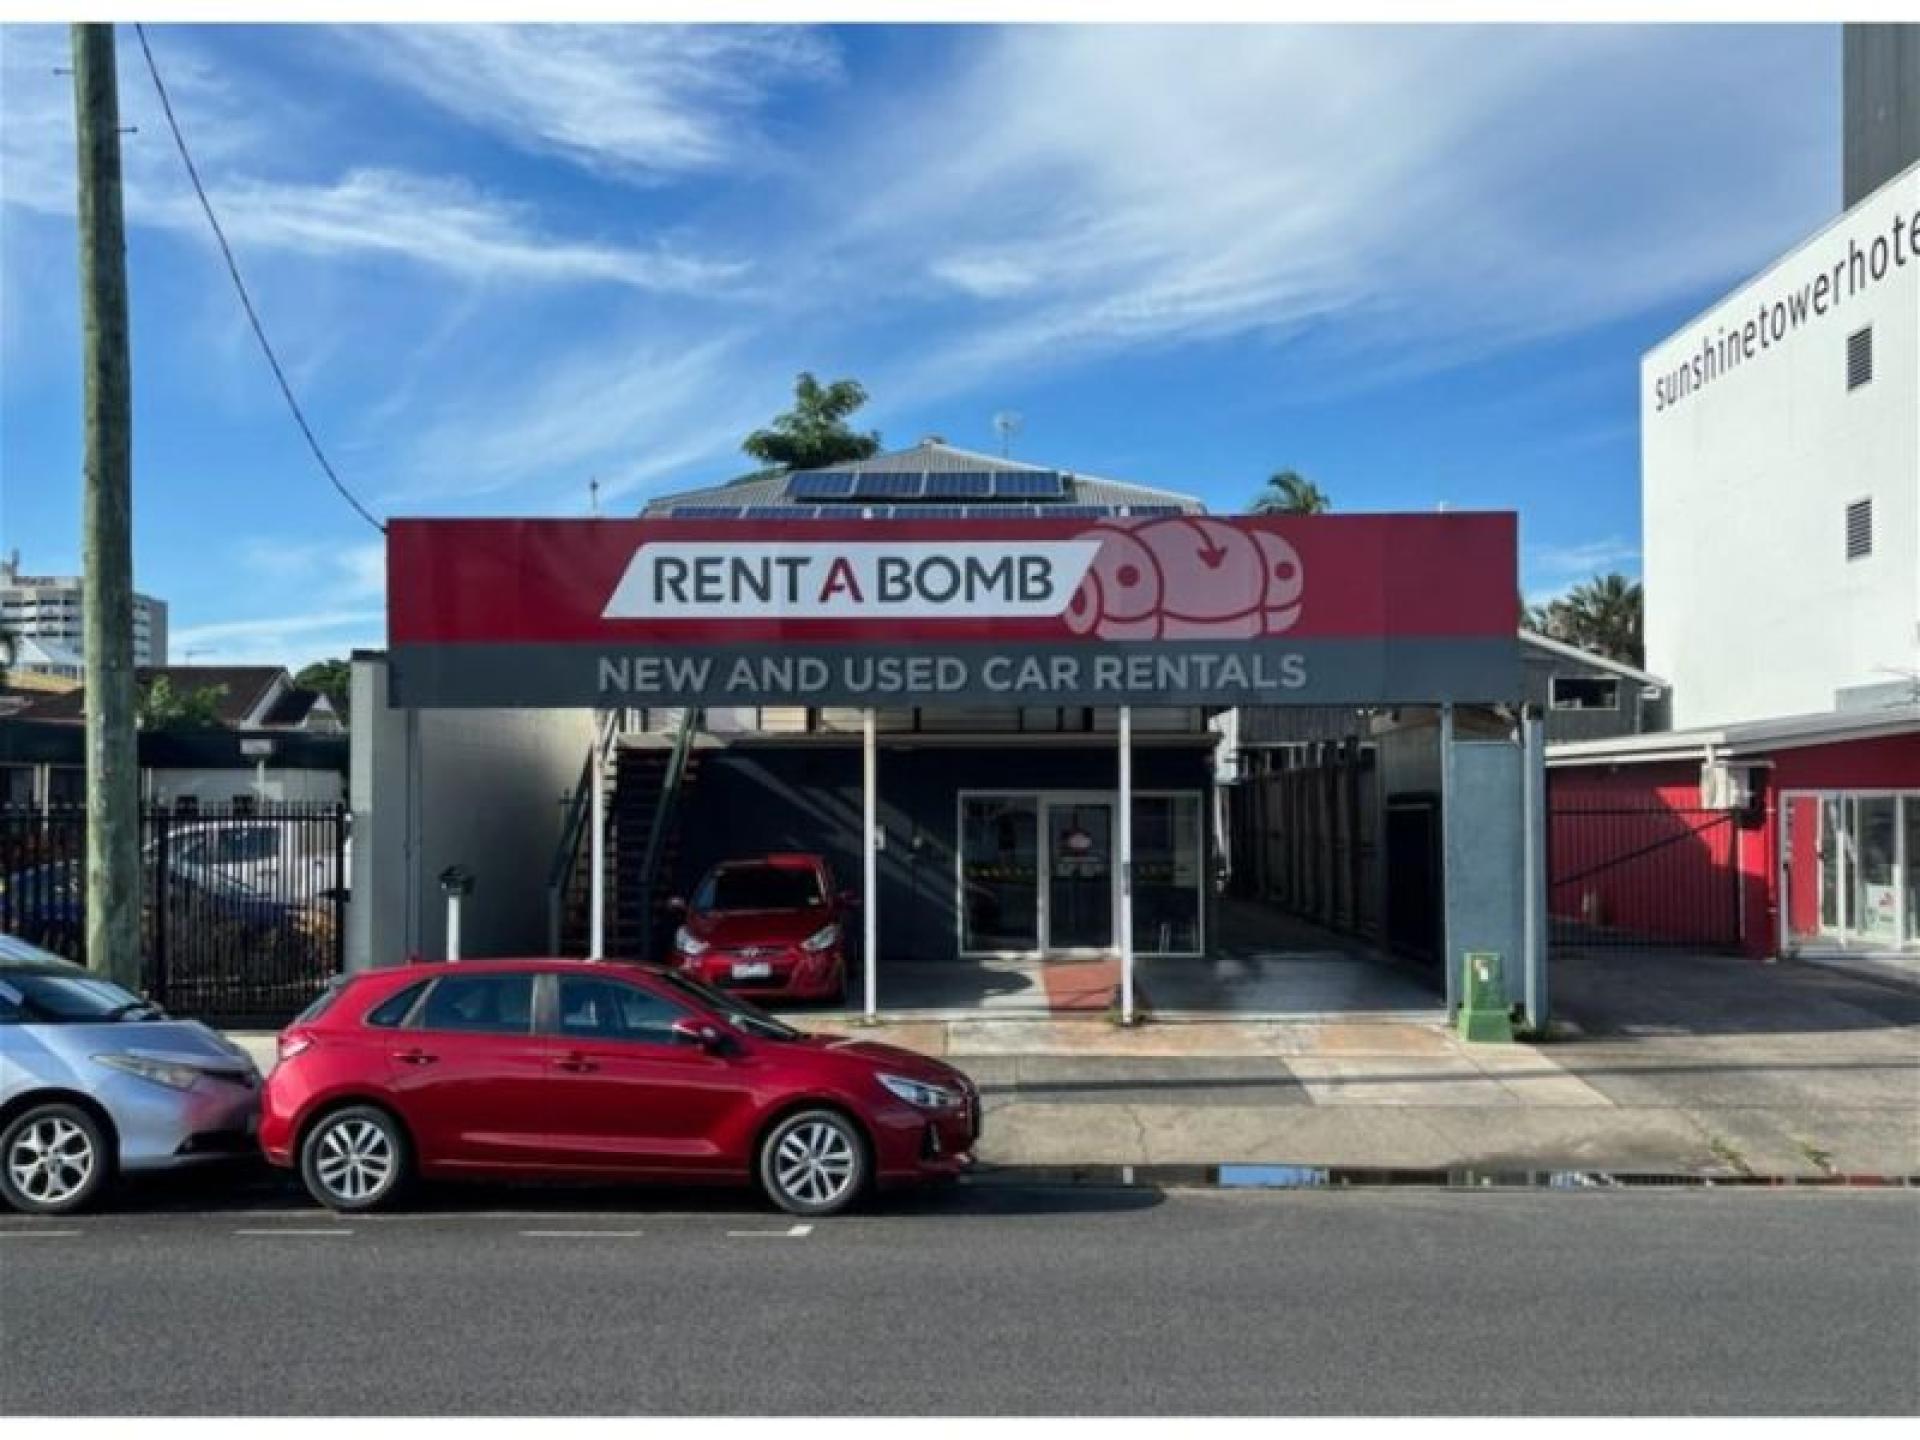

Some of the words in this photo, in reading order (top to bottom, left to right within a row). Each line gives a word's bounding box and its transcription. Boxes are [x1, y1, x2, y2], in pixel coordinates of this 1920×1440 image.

[653, 556, 812, 603] RENT
[818, 556, 865, 602] A
[877, 556, 1054, 603] BOMB
[598, 656, 711, 693] NEW
[726, 656, 829, 693] AND
[844, 655, 969, 693] USED
[982, 655, 1078, 693] CAR
[1094, 654, 1308, 692] RENTALS
